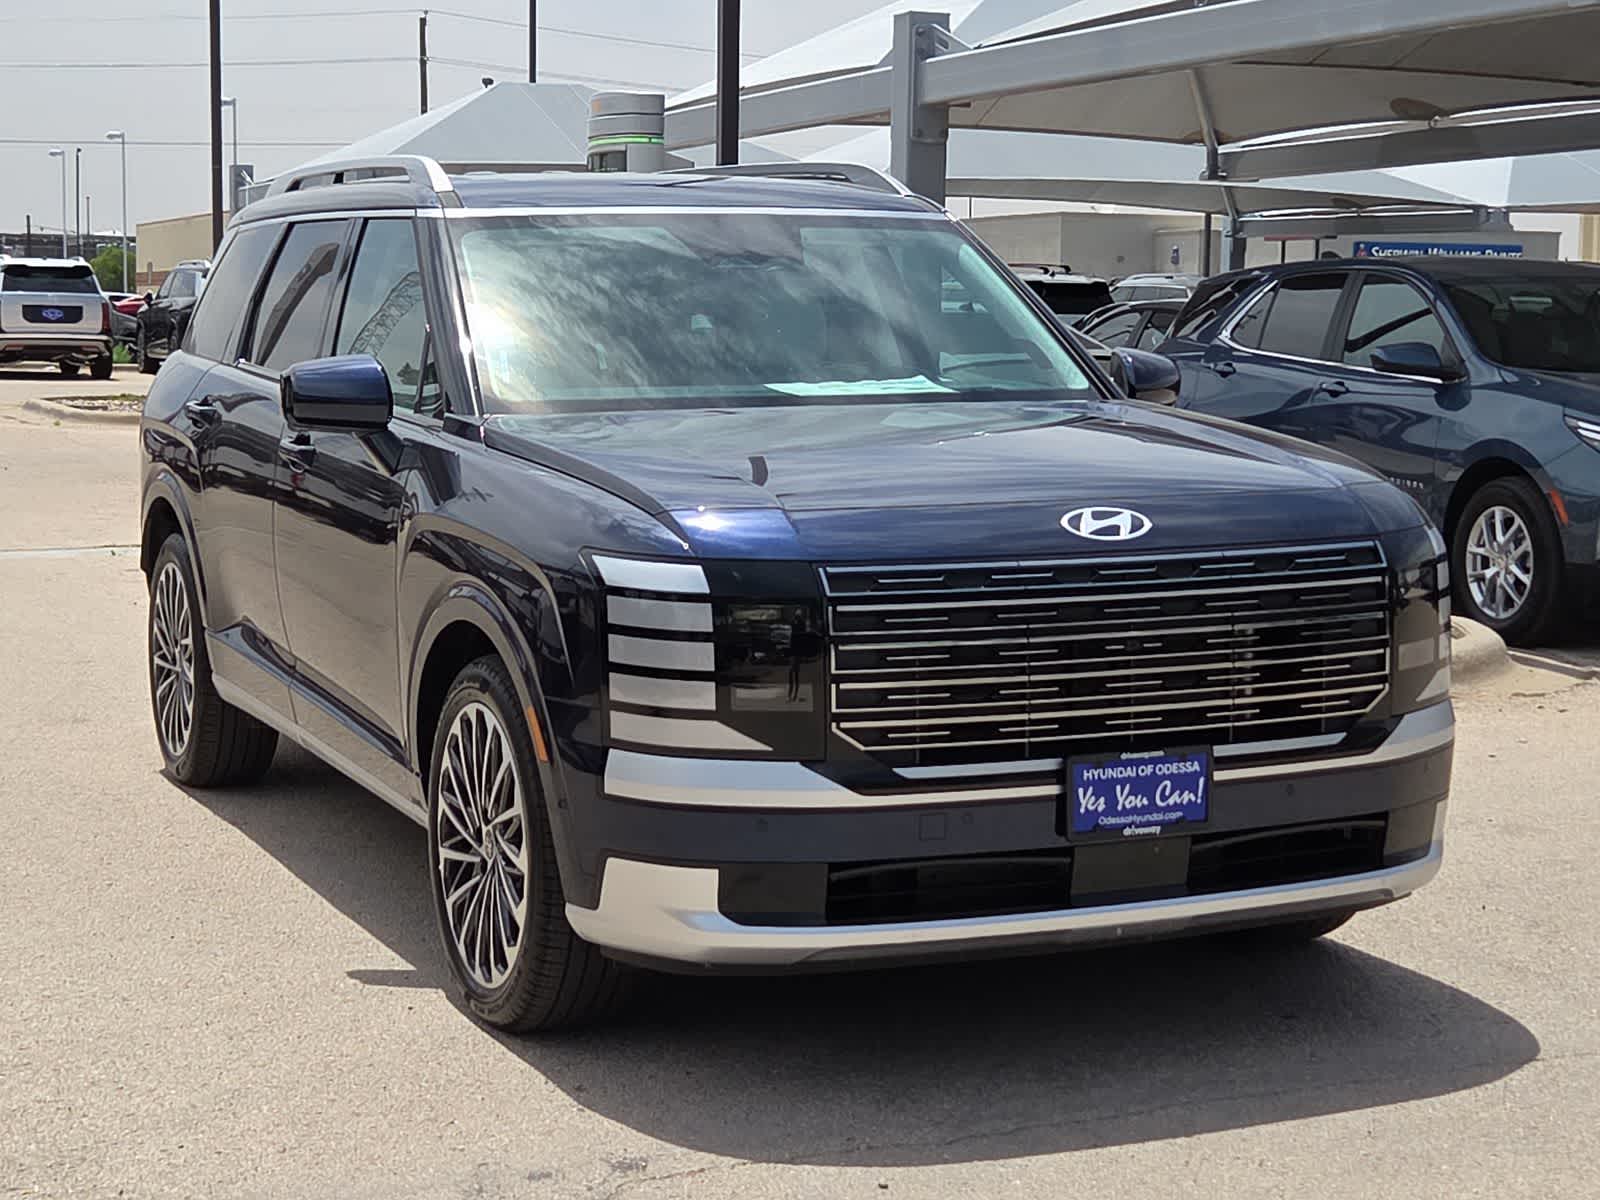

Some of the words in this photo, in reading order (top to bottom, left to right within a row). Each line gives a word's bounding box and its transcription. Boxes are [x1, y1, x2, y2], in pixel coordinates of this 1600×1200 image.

[1083, 767, 1136, 781] HYUNDAI
[1138, 765, 1153, 776] OF
[1155, 761, 1200, 775] ODESSA
[1078, 786, 1106, 814] Yes
[1116, 783, 1149, 811] You
[1155, 776, 1204, 807] Can!
